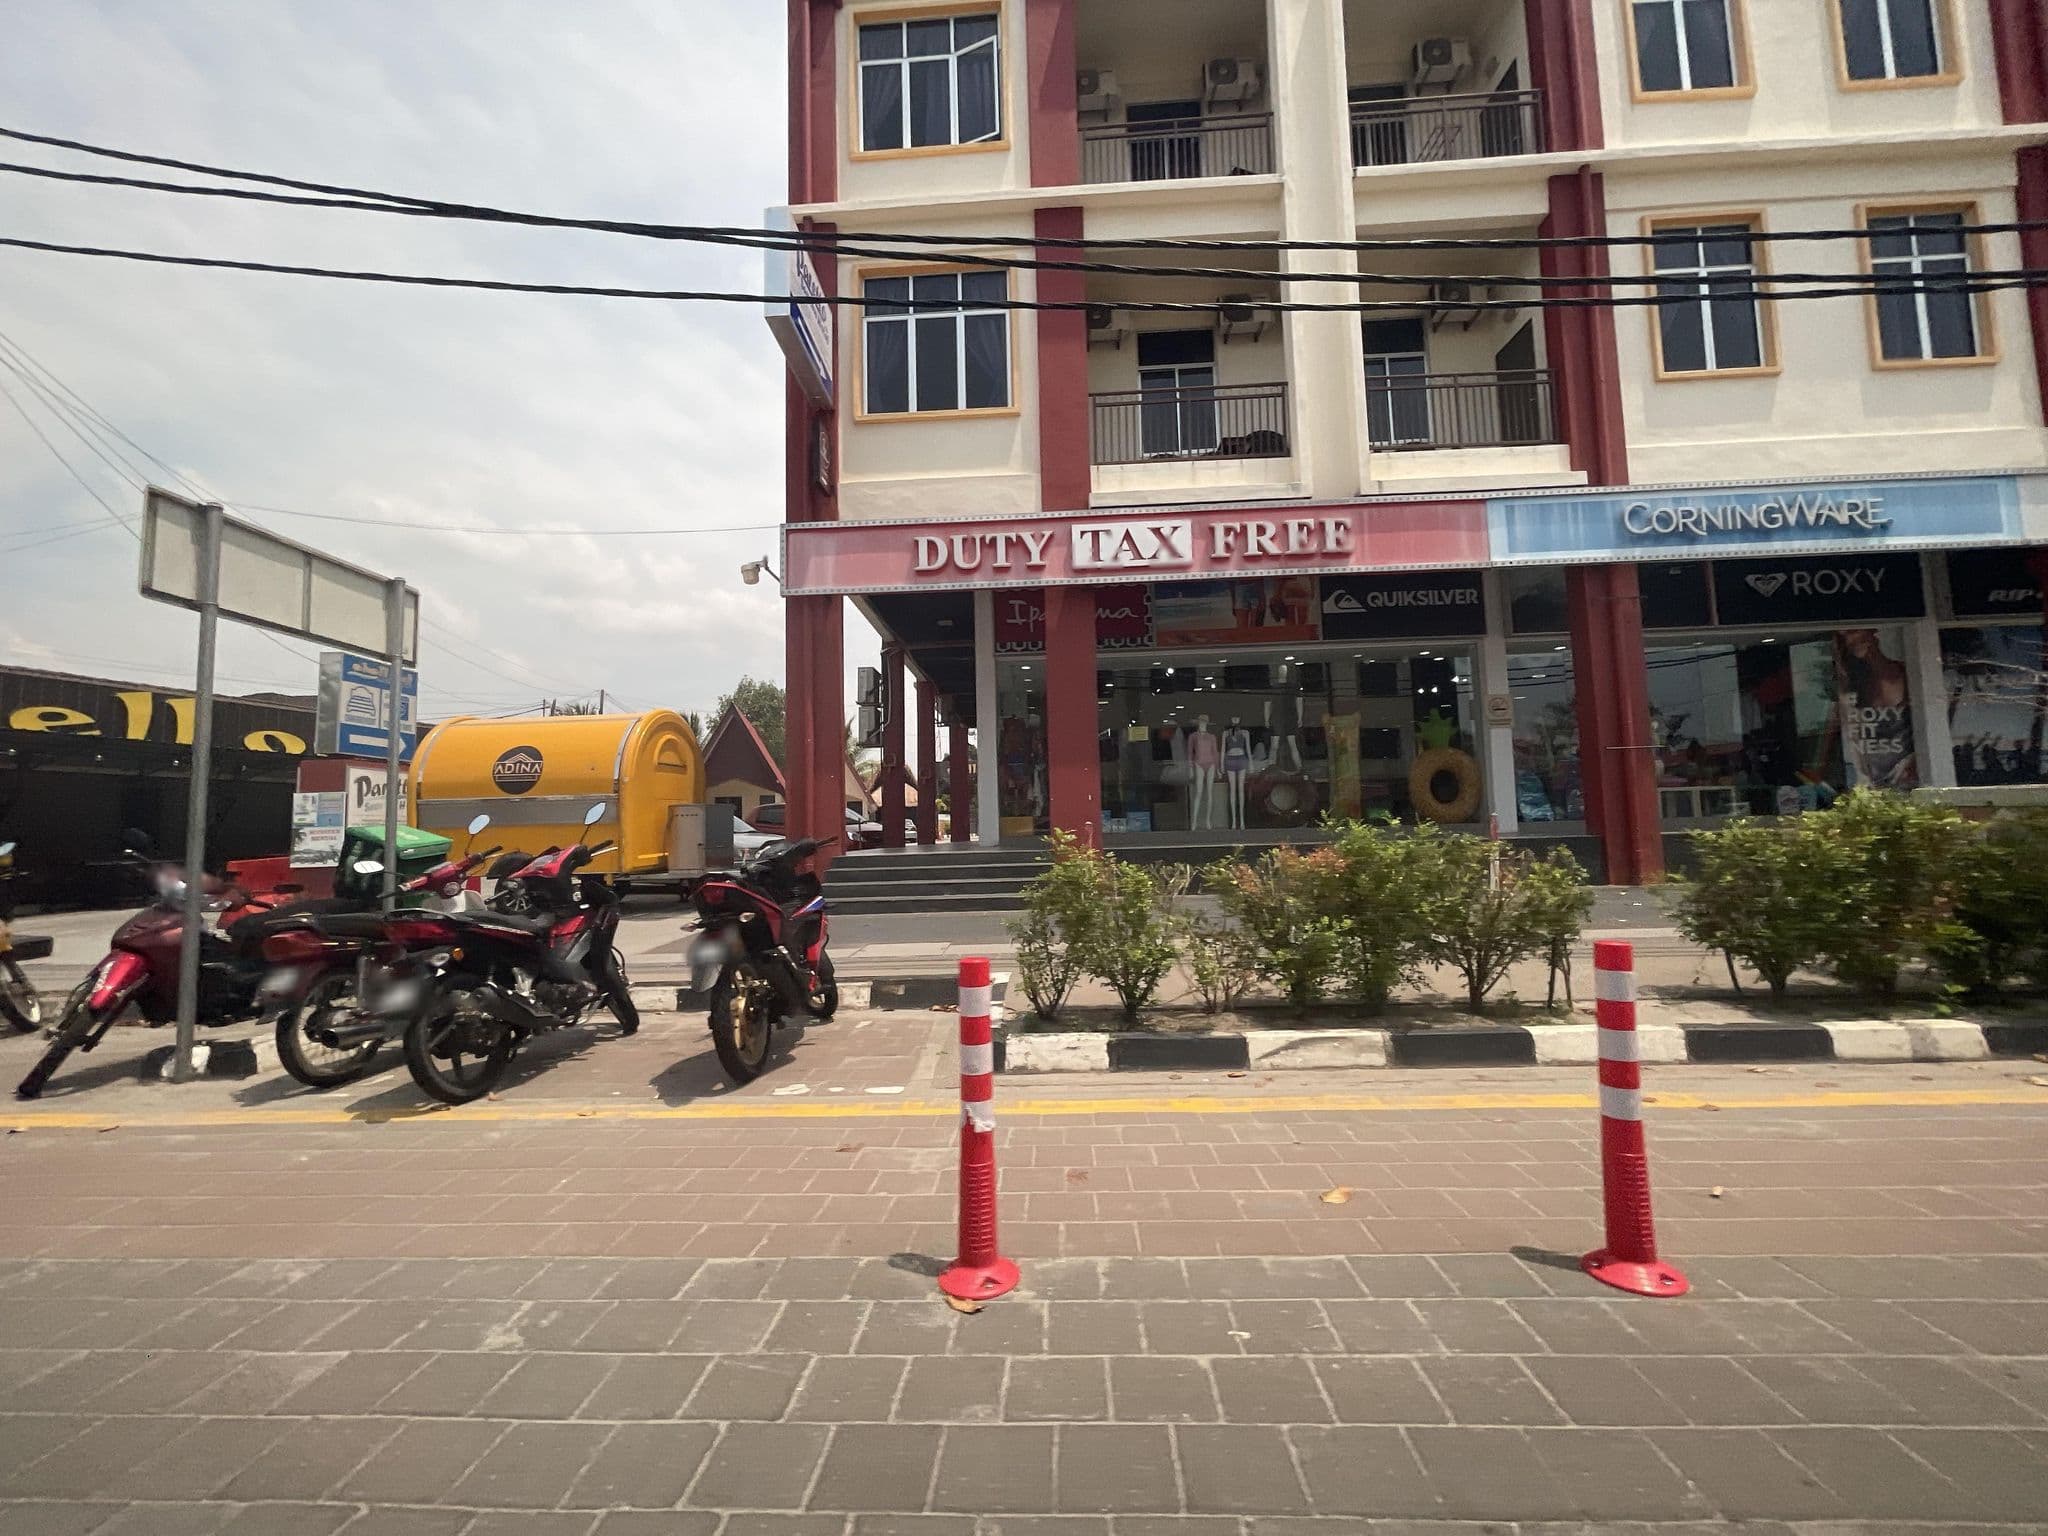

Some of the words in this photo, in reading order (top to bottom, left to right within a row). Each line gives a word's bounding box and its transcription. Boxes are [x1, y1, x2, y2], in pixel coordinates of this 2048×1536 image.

[913, 530, 1055, 572] DUTY
[1080, 525, 1183, 563] TAX
[1210, 518, 1355, 559] FREE
[1791, 567, 1885, 596] ROXY
[1367, 588, 1479, 608] QUIKSILVER
[1847, 706, 1904, 723] ROXY
[494, 762, 541, 775] ADINA
